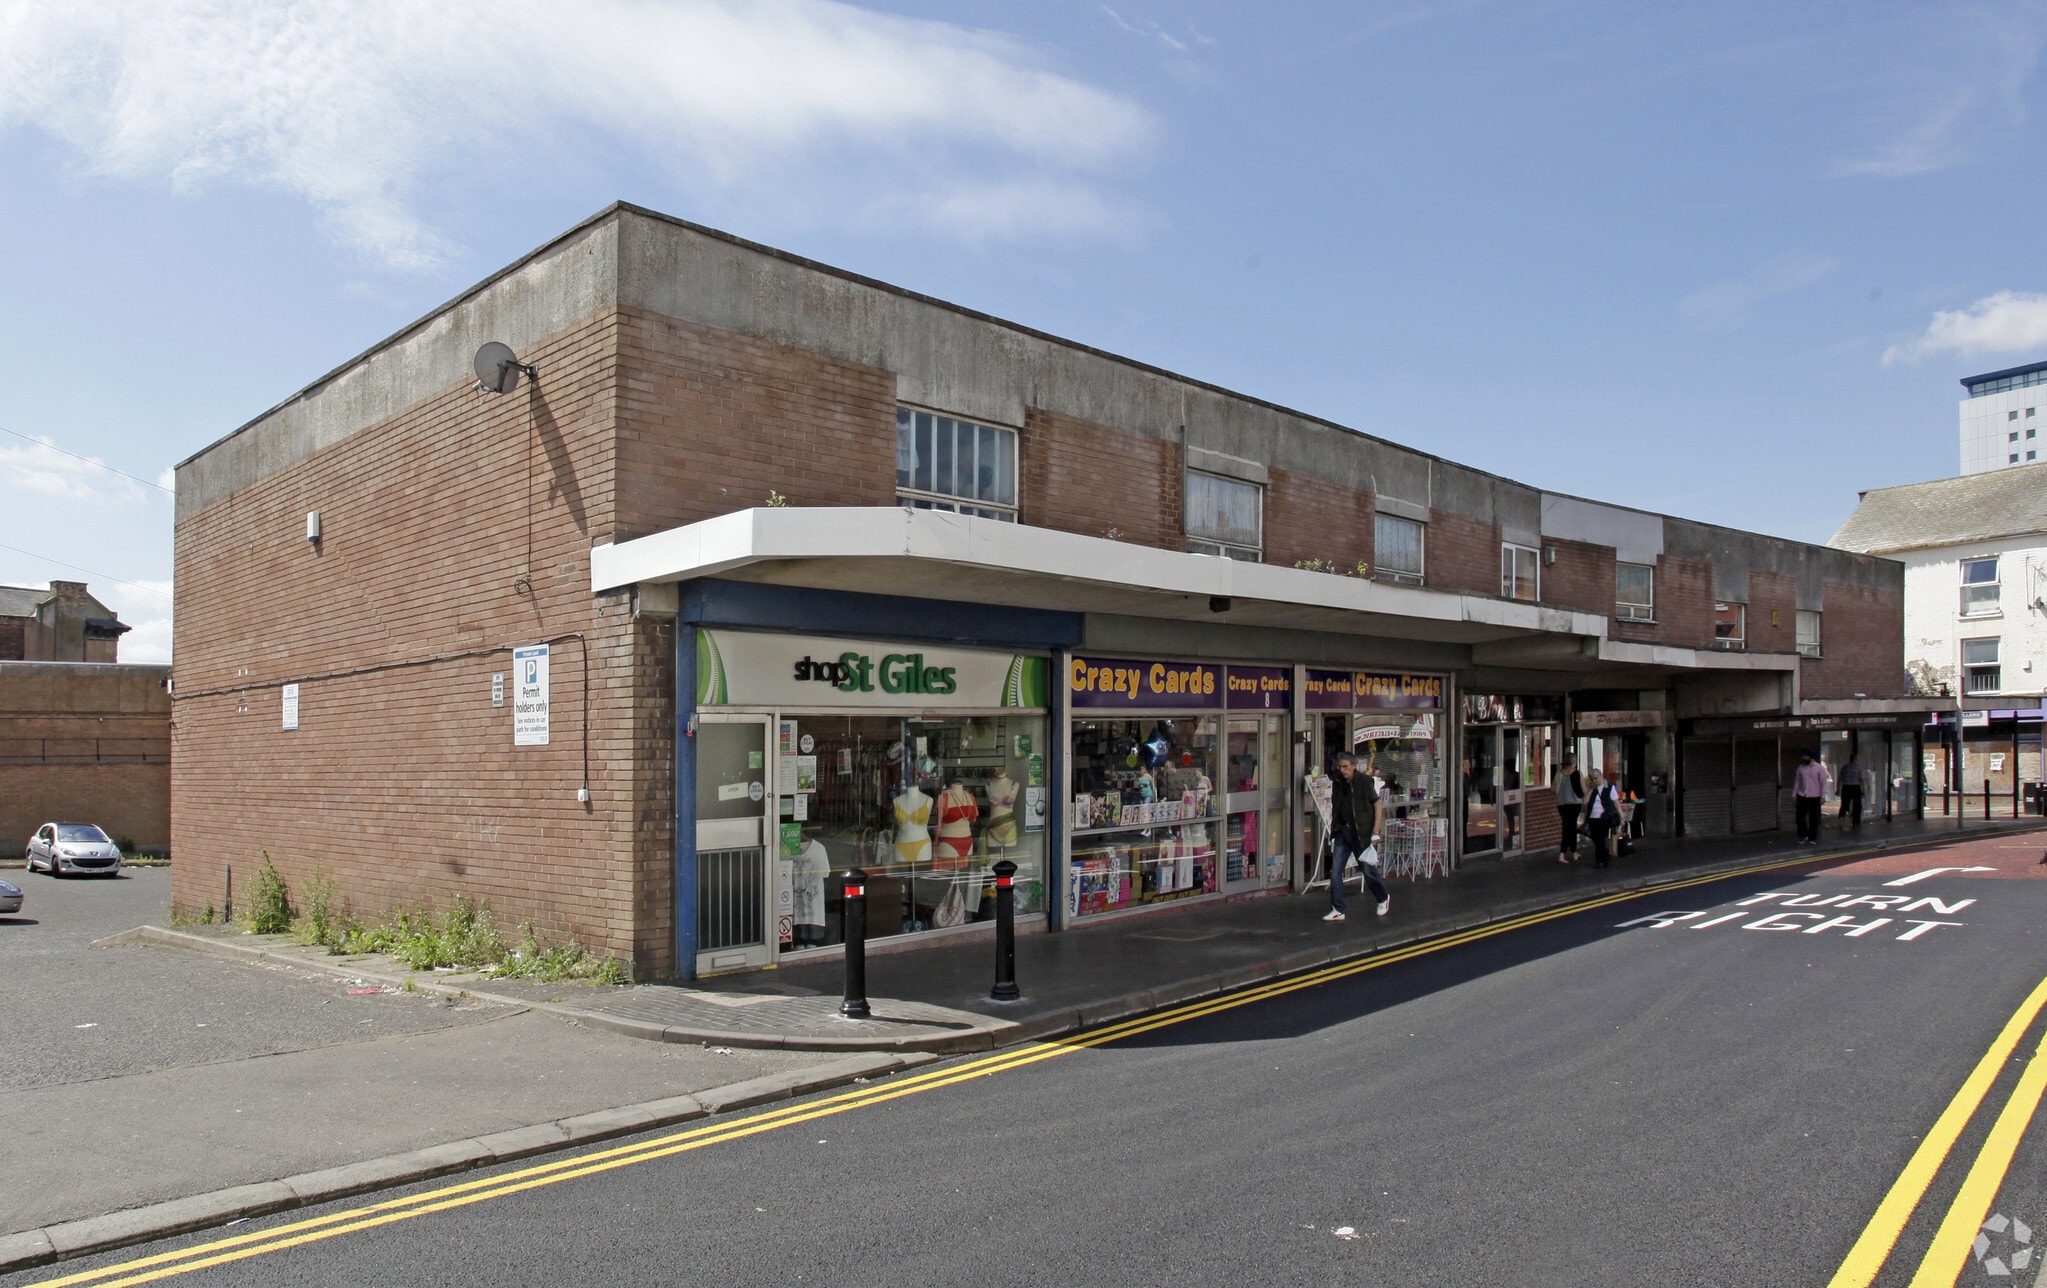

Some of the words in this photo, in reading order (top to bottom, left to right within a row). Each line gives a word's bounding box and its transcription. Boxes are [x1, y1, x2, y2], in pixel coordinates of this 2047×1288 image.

[794, 656, 850, 687] shop
[839, 652, 874, 692] St
[880, 654, 957, 695] Giles
[1071, 659, 1141, 700] Crazy
[1149, 663, 1215, 695] Cards
[522, 685, 540, 699] Permit
[1228, 675, 1258, 694] Crazy
[1261, 675, 1290, 691] Cards
[1326, 678, 1351, 692] Cards
[1355, 672, 1397, 702] Crazy
[1401, 675, 1440, 697] Cards
[516, 701, 535, 714] holders
[536, 699, 547, 715] only
[1264, 692, 1270, 707] 8
[1735, 892, 1978, 915] TURN
[1613, 910, 1966, 941] RIGHT
